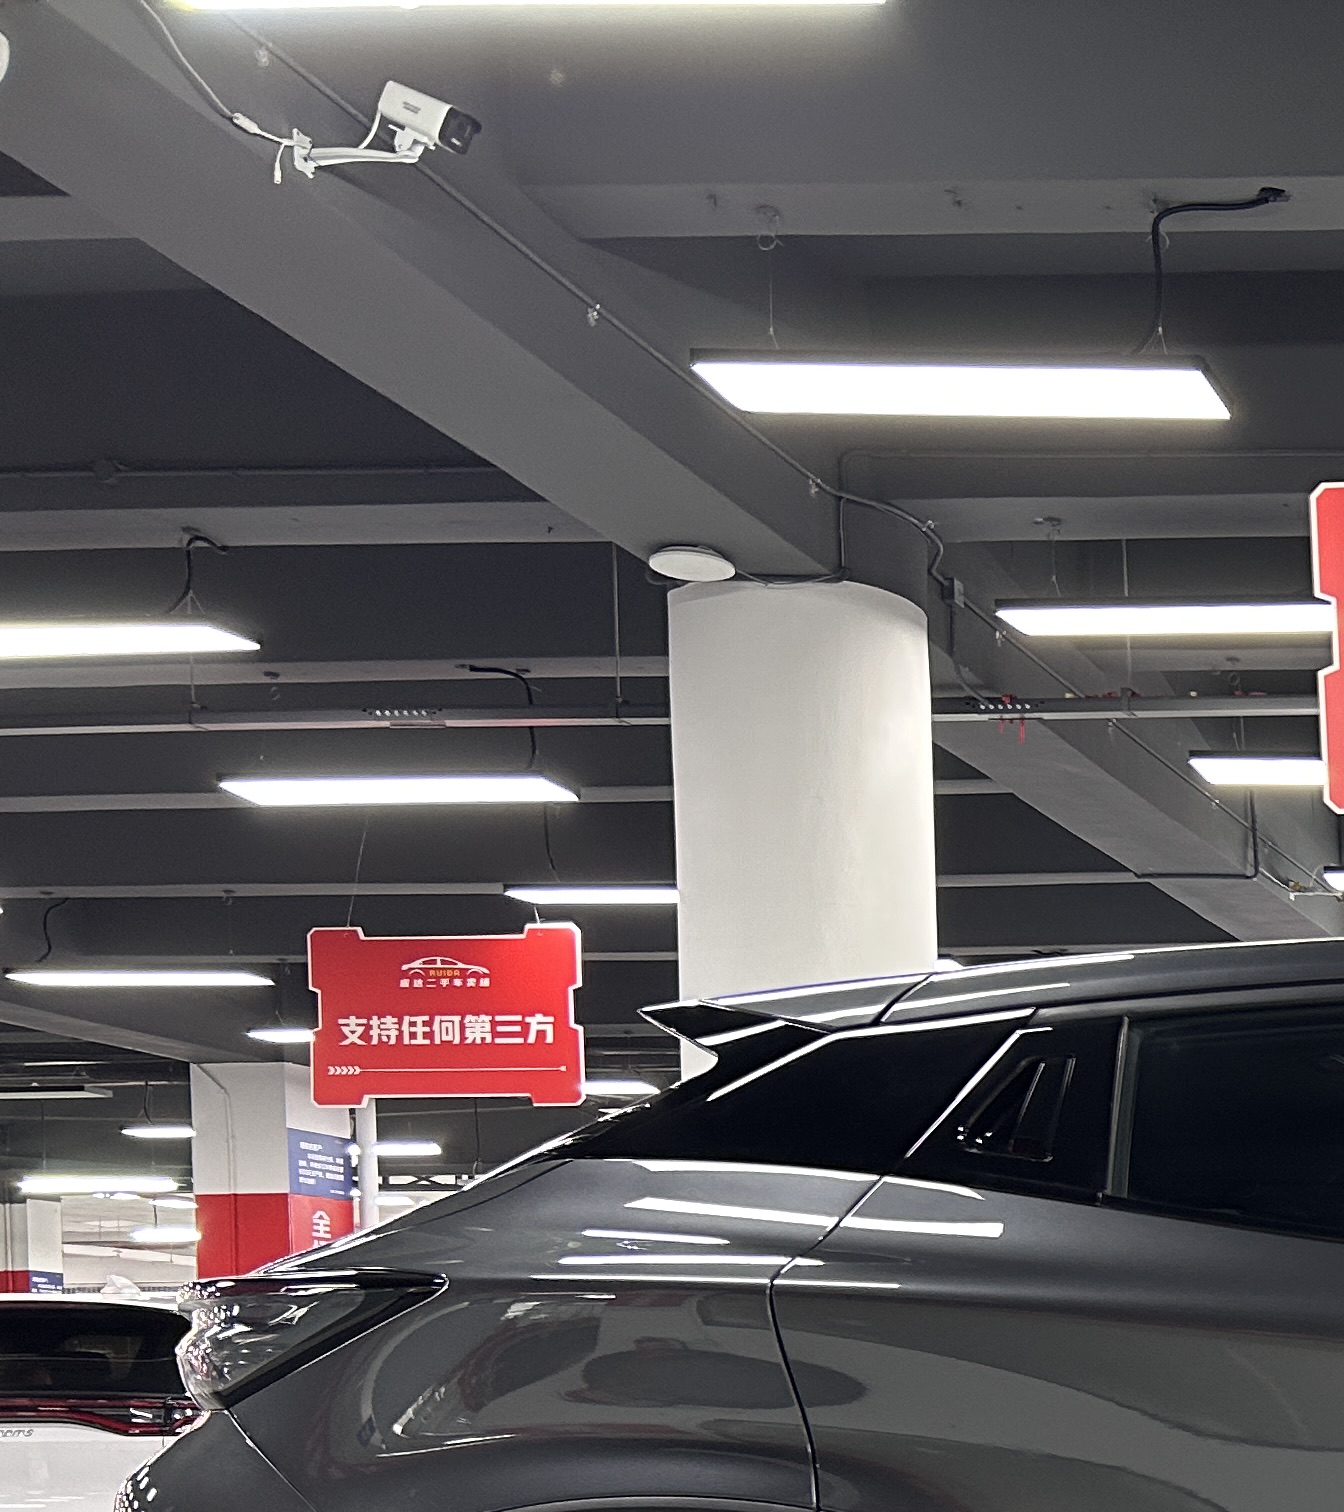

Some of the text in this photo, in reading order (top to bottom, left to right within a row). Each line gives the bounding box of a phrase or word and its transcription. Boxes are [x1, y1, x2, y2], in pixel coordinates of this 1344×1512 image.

[337, 1013, 554, 1045] 支持任何第三方
